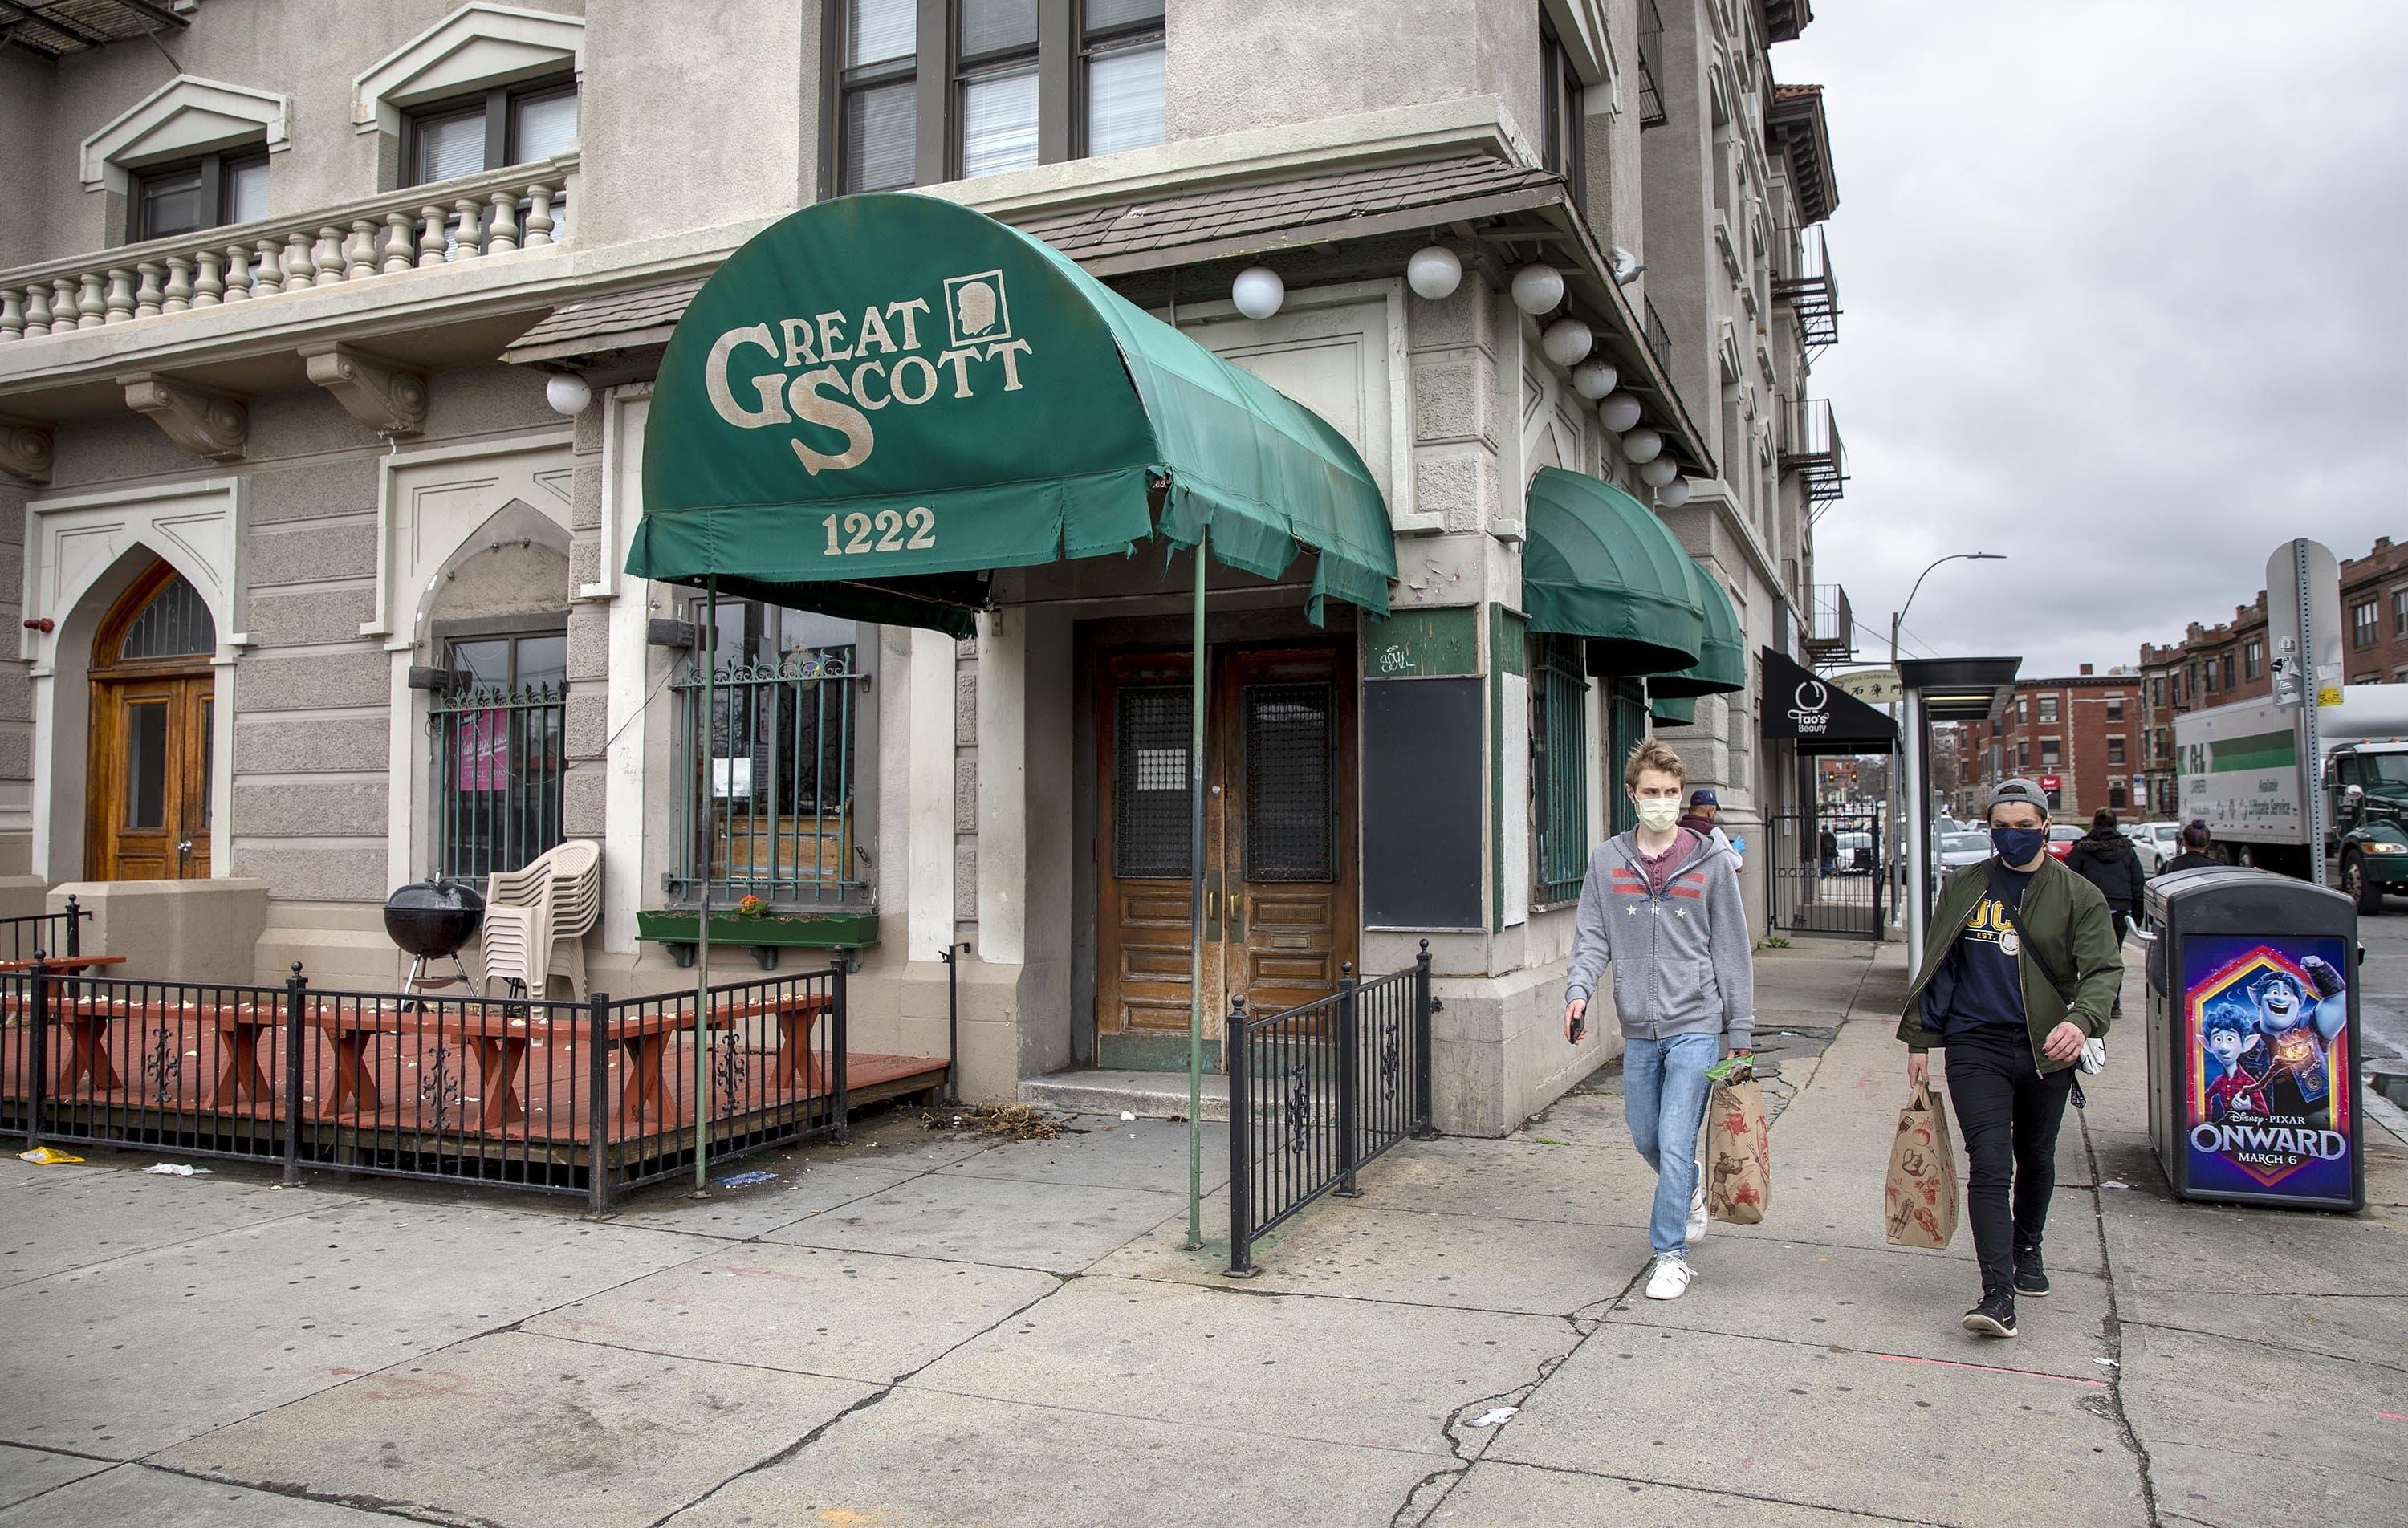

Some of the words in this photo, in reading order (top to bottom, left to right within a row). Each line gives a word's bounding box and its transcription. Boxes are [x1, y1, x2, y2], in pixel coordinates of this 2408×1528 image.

[706, 297, 930, 429] GREAT
[788, 338, 1032, 476] SCOTT
[821, 506, 936, 555] 1222
[1788, 709, 1830, 724] Tao's
[1798, 725, 1826, 734] Beauty
[1977, 932, 1996, 941] EST.
[2227, 1110, 2264, 1125] Disney
[2269, 1115, 2305, 1124] PIXAR
[2190, 1124, 2346, 1160] ONWARD
[2239, 1152, 2283, 1166] MARCH
[2288, 1155, 2297, 1164] 6
